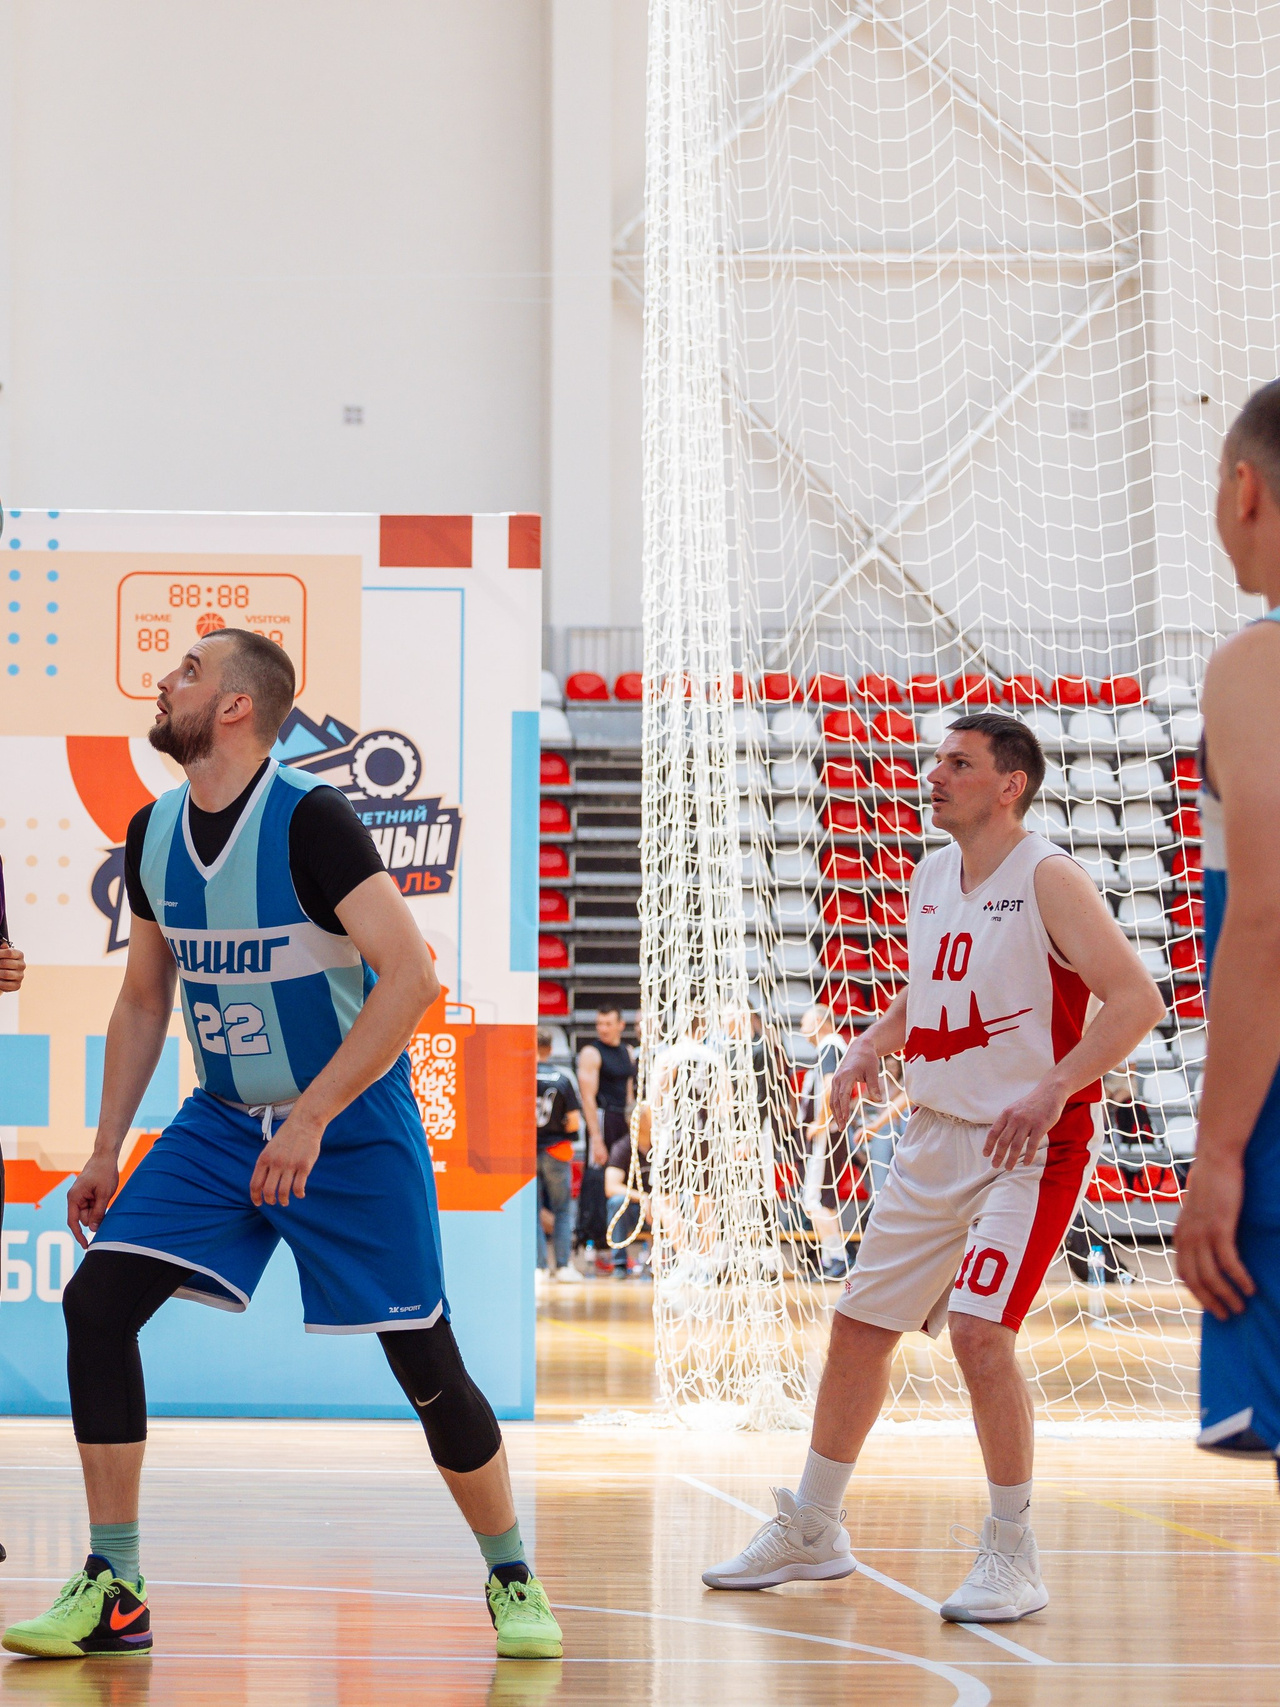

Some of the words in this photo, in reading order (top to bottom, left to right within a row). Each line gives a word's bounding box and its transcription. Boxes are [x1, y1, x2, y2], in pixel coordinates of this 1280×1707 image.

[169, 584, 249, 608] 88:88
[135, 613, 172, 623] HOME
[245, 615, 291, 625] VISITOR
[137, 628, 169, 652] 88
[356, 805, 428, 826] ЕТНИЙ
[932, 932, 973, 982] 10
[193, 1001, 272, 1056] 22
[954, 1245, 1009, 1297] 10
[400, 1304, 422, 1313] SPORT
